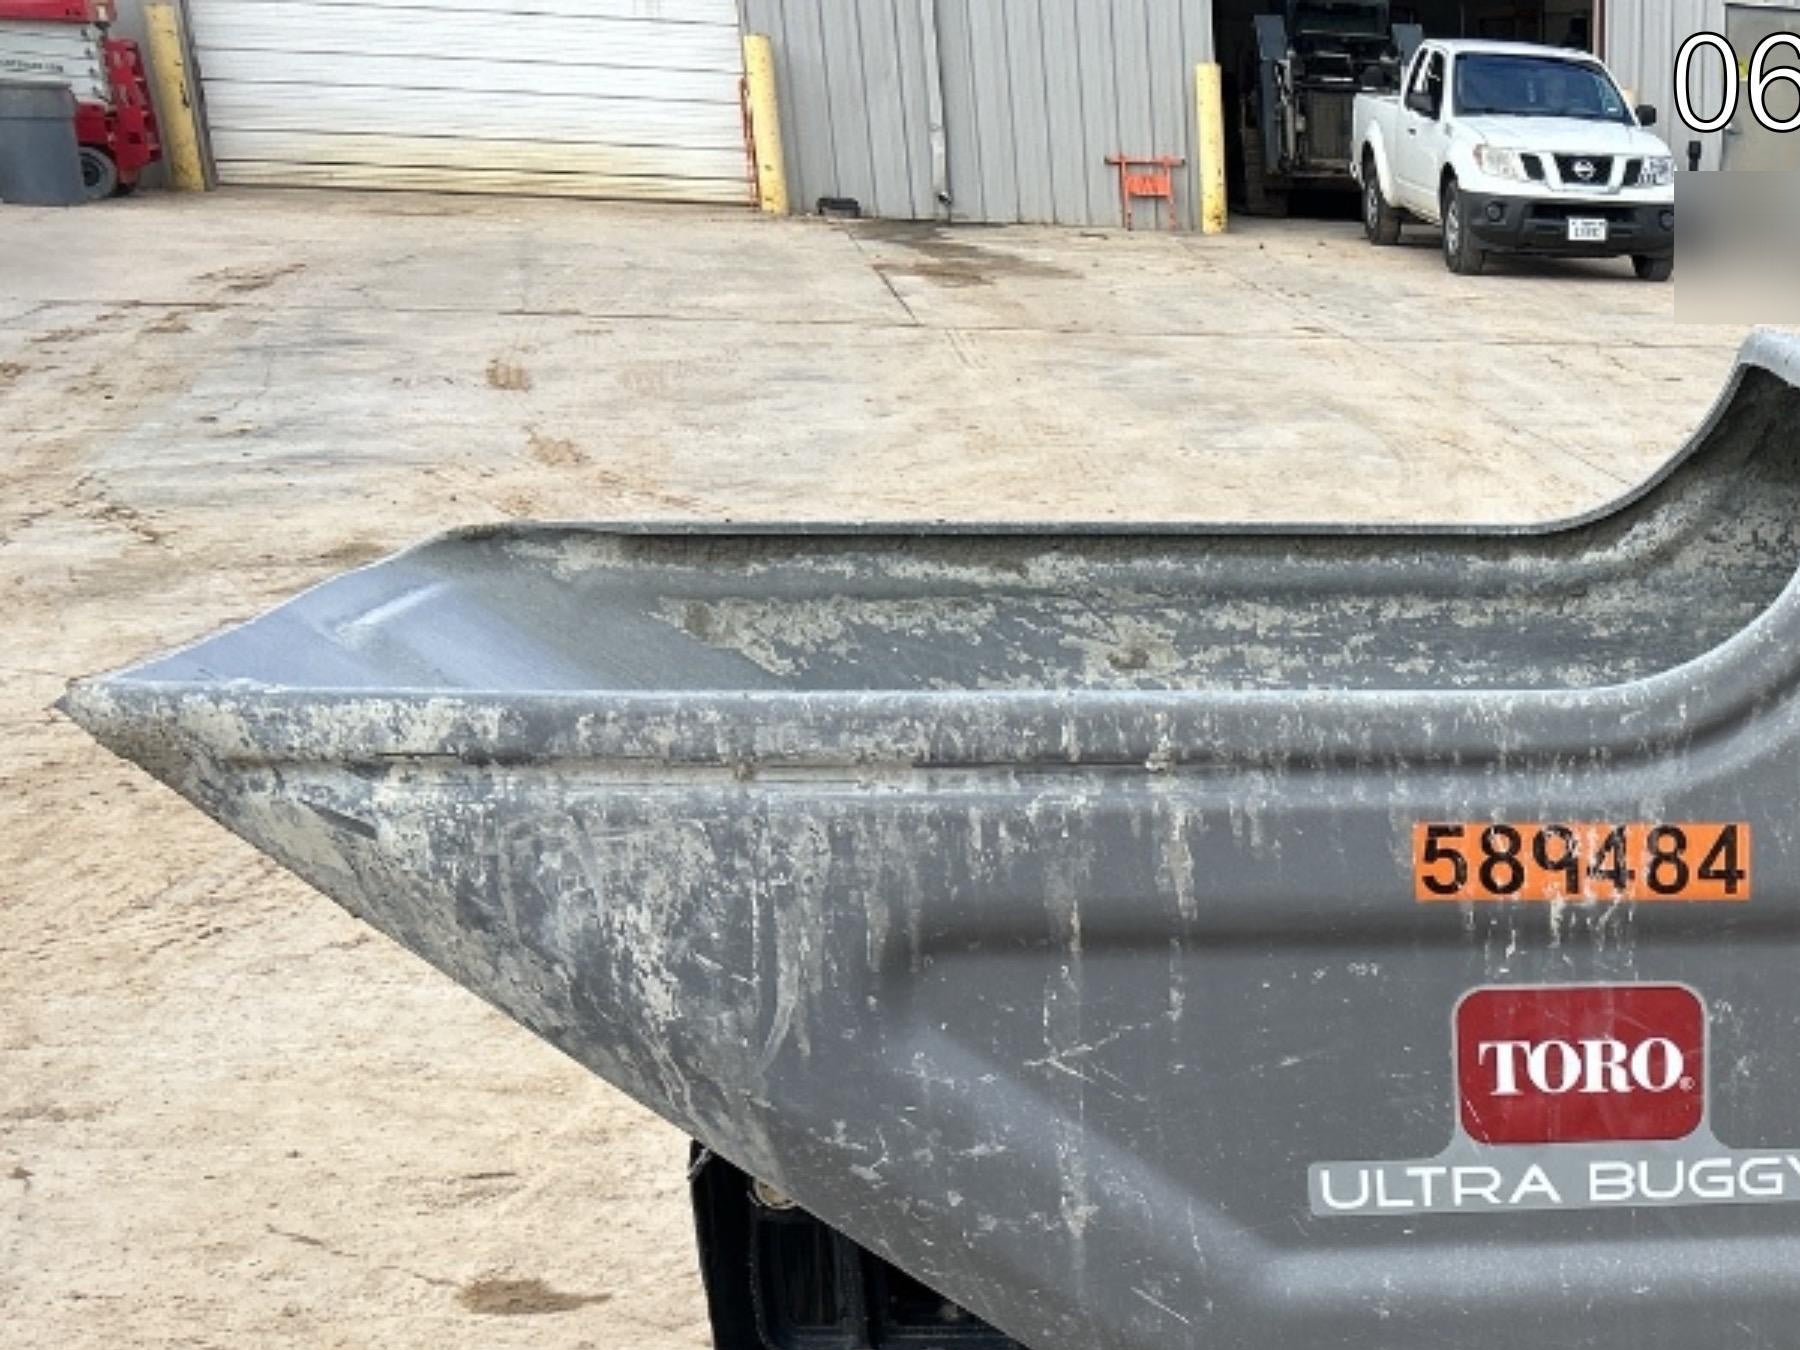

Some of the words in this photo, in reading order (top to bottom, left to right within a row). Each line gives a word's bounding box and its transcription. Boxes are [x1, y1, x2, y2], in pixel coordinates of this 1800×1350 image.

[1421, 824, 1746, 895] 589484
[1479, 1037, 1684, 1096] TORO
[1321, 1166, 1561, 1209] ULTRA
